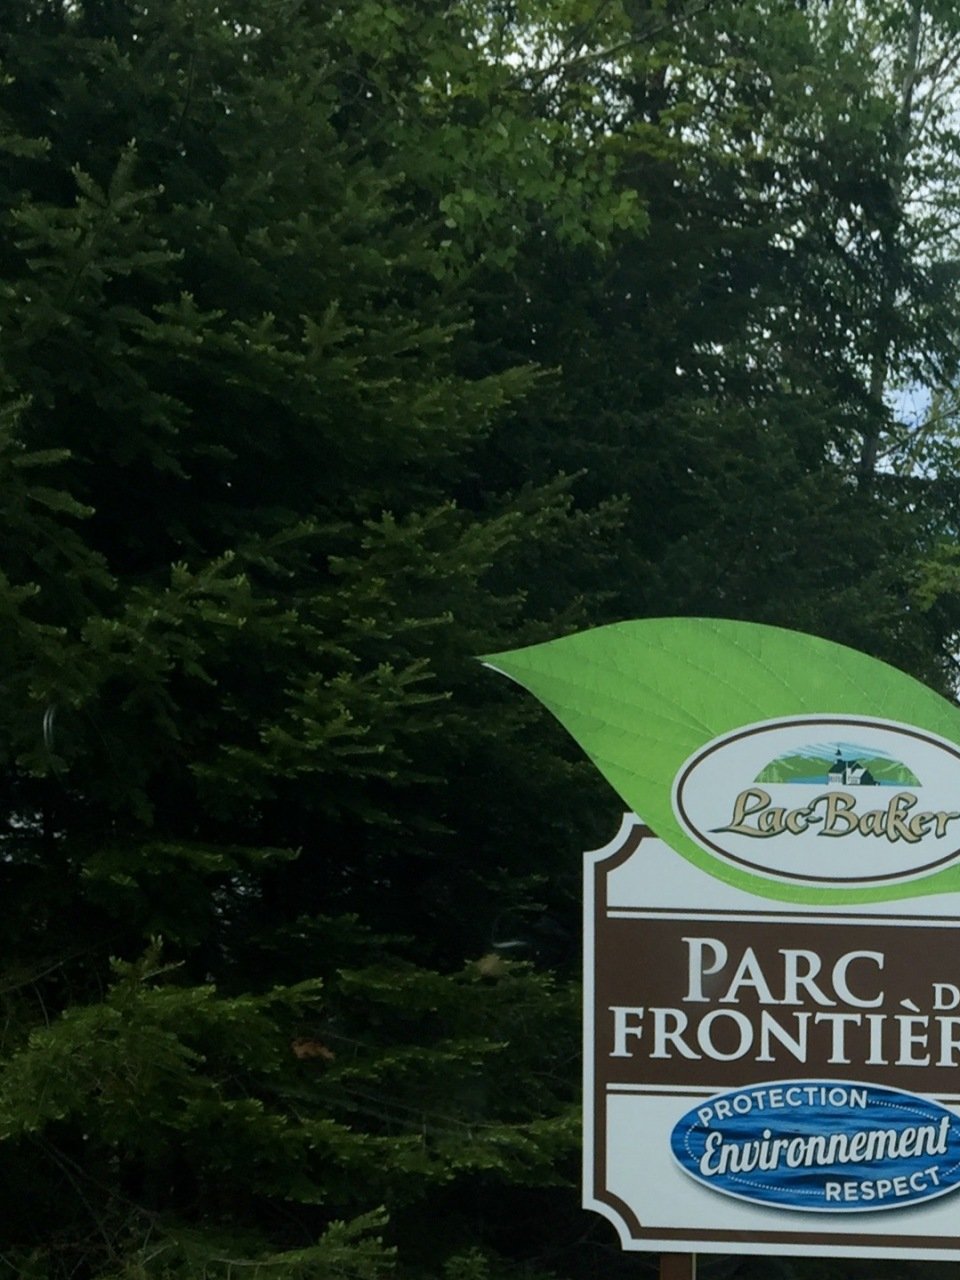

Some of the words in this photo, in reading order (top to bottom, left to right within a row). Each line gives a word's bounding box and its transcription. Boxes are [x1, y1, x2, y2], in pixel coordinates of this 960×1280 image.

[681, 936, 885, 1008] PARC
[696, 1086, 869, 1128] PROTECTION
[699, 1115, 952, 1177] Environnement
[825, 1165, 942, 1202] RESPECT
